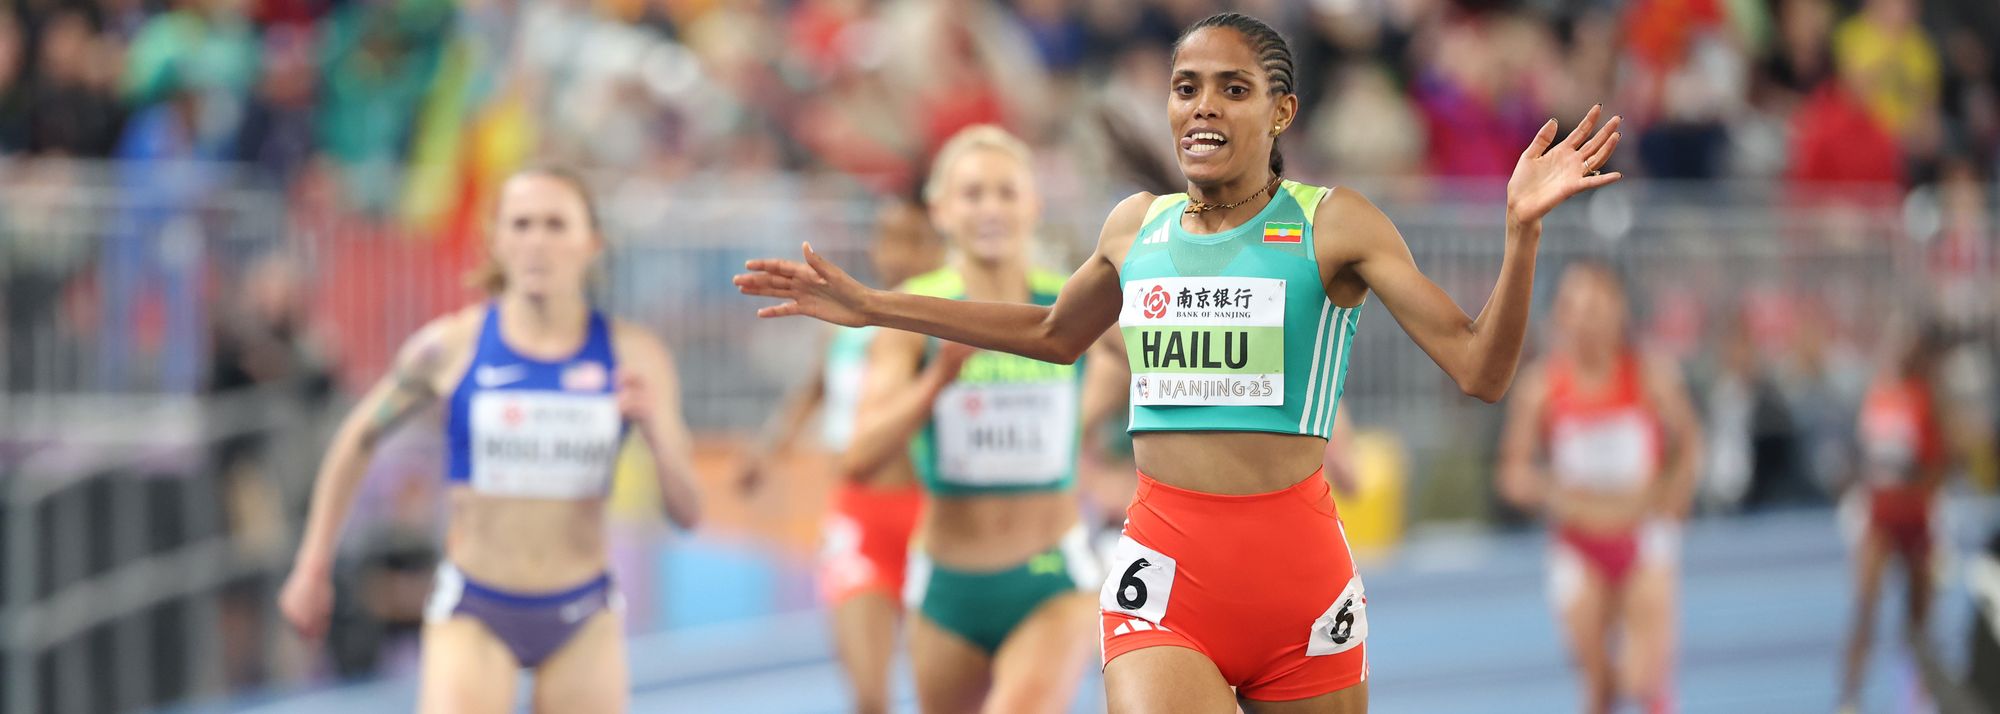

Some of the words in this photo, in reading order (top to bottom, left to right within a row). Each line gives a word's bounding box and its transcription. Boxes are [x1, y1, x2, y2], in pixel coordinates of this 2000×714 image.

[1176, 287, 1253, 309] 南京银行
[1214, 311, 1251, 319] NANJING
[1142, 331, 1248, 369] HAILU
[1116, 557, 1150, 610] 6
[1330, 597, 1355, 644] 6
